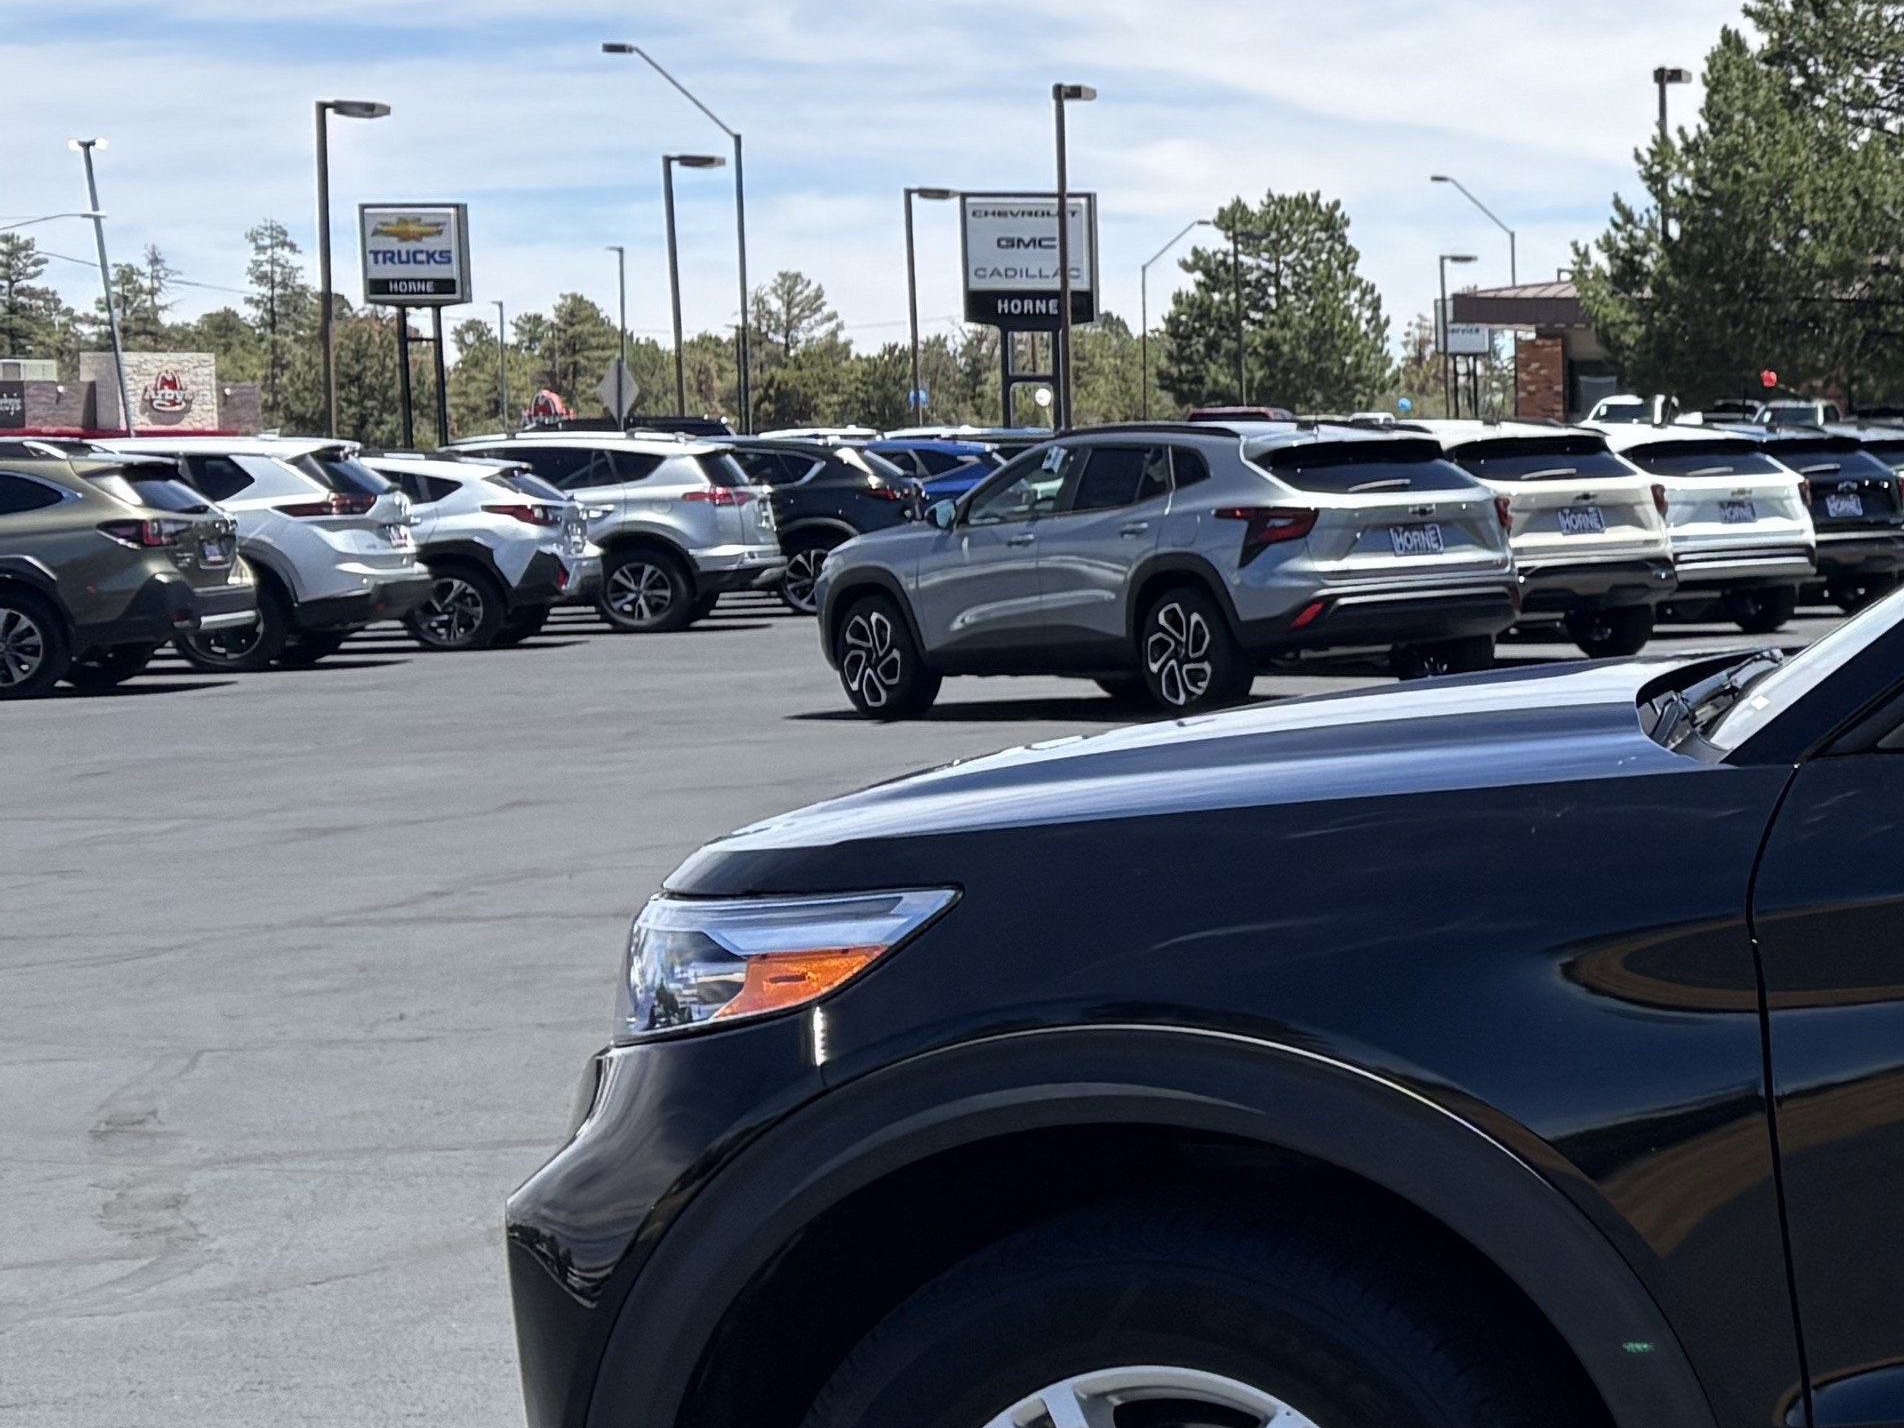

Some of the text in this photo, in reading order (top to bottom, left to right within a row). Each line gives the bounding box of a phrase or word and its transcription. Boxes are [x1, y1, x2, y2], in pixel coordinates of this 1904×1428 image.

[971, 209, 1078, 219] CHEVROLT
[996, 236, 1058, 250] GMC
[369, 249, 453, 266] TRUCKS
[388, 279, 435, 294] HORNE
[997, 298, 1060, 315] HORNE
[1393, 529, 1440, 554] HORNE
